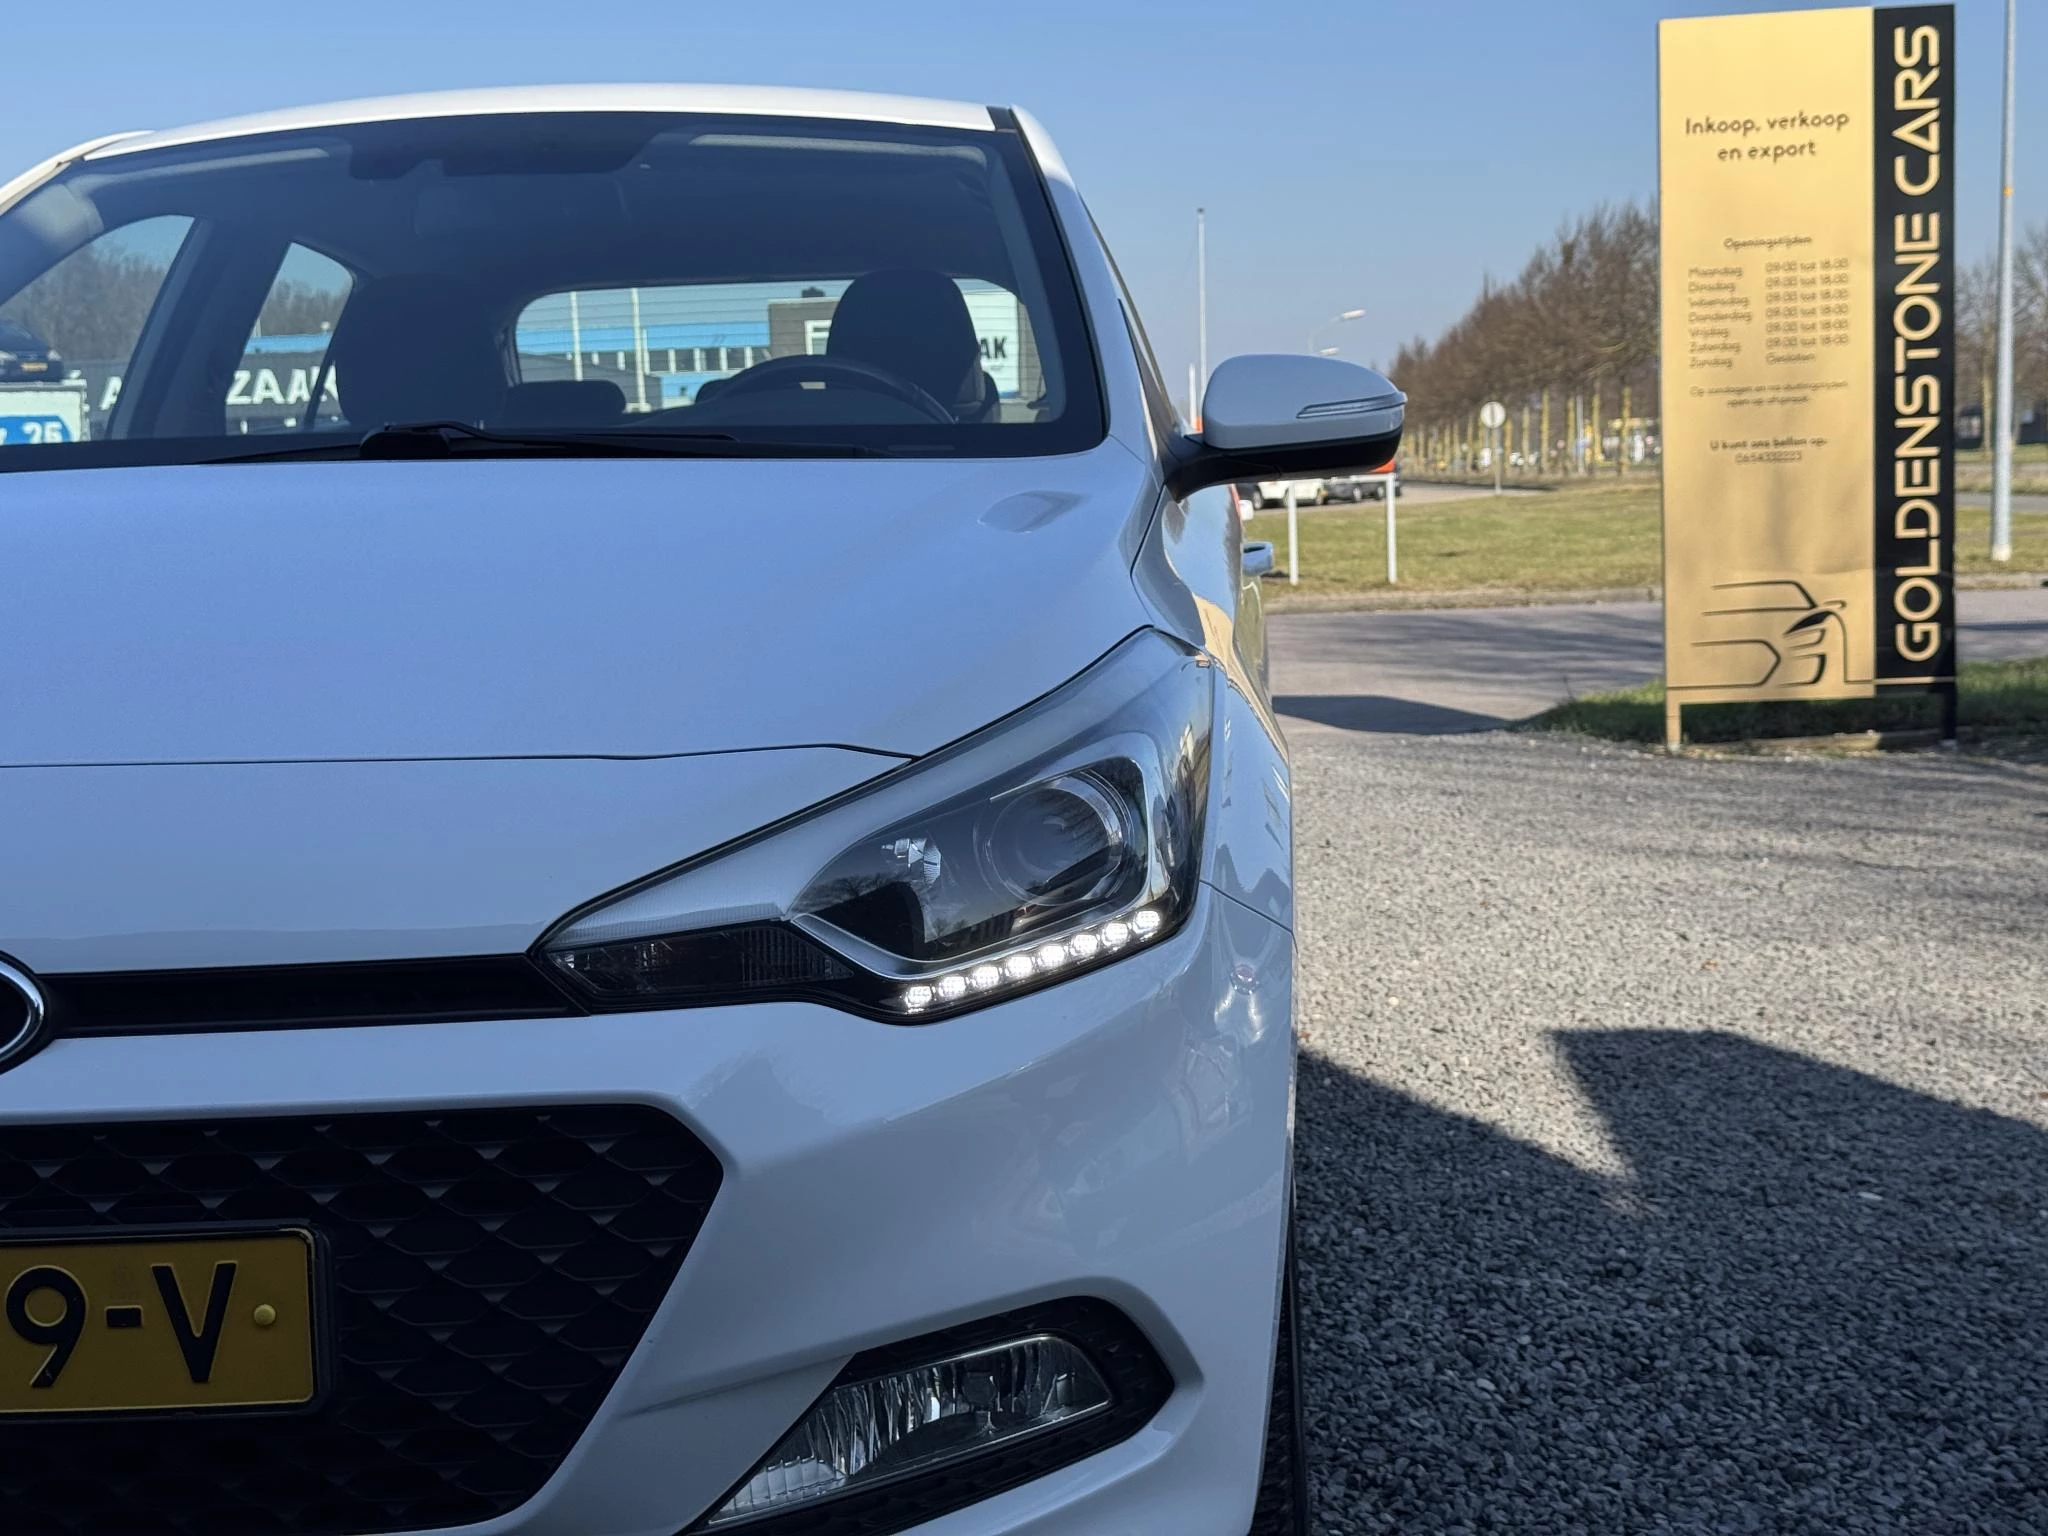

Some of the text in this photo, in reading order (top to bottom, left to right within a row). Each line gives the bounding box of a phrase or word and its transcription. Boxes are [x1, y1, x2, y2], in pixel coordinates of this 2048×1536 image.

[1685, 109, 1850, 137] Inkoop, verkoop
[1717, 140, 1817, 162] en export
[1891, 24, 1942, 663] GOLDENSTONE CARS
